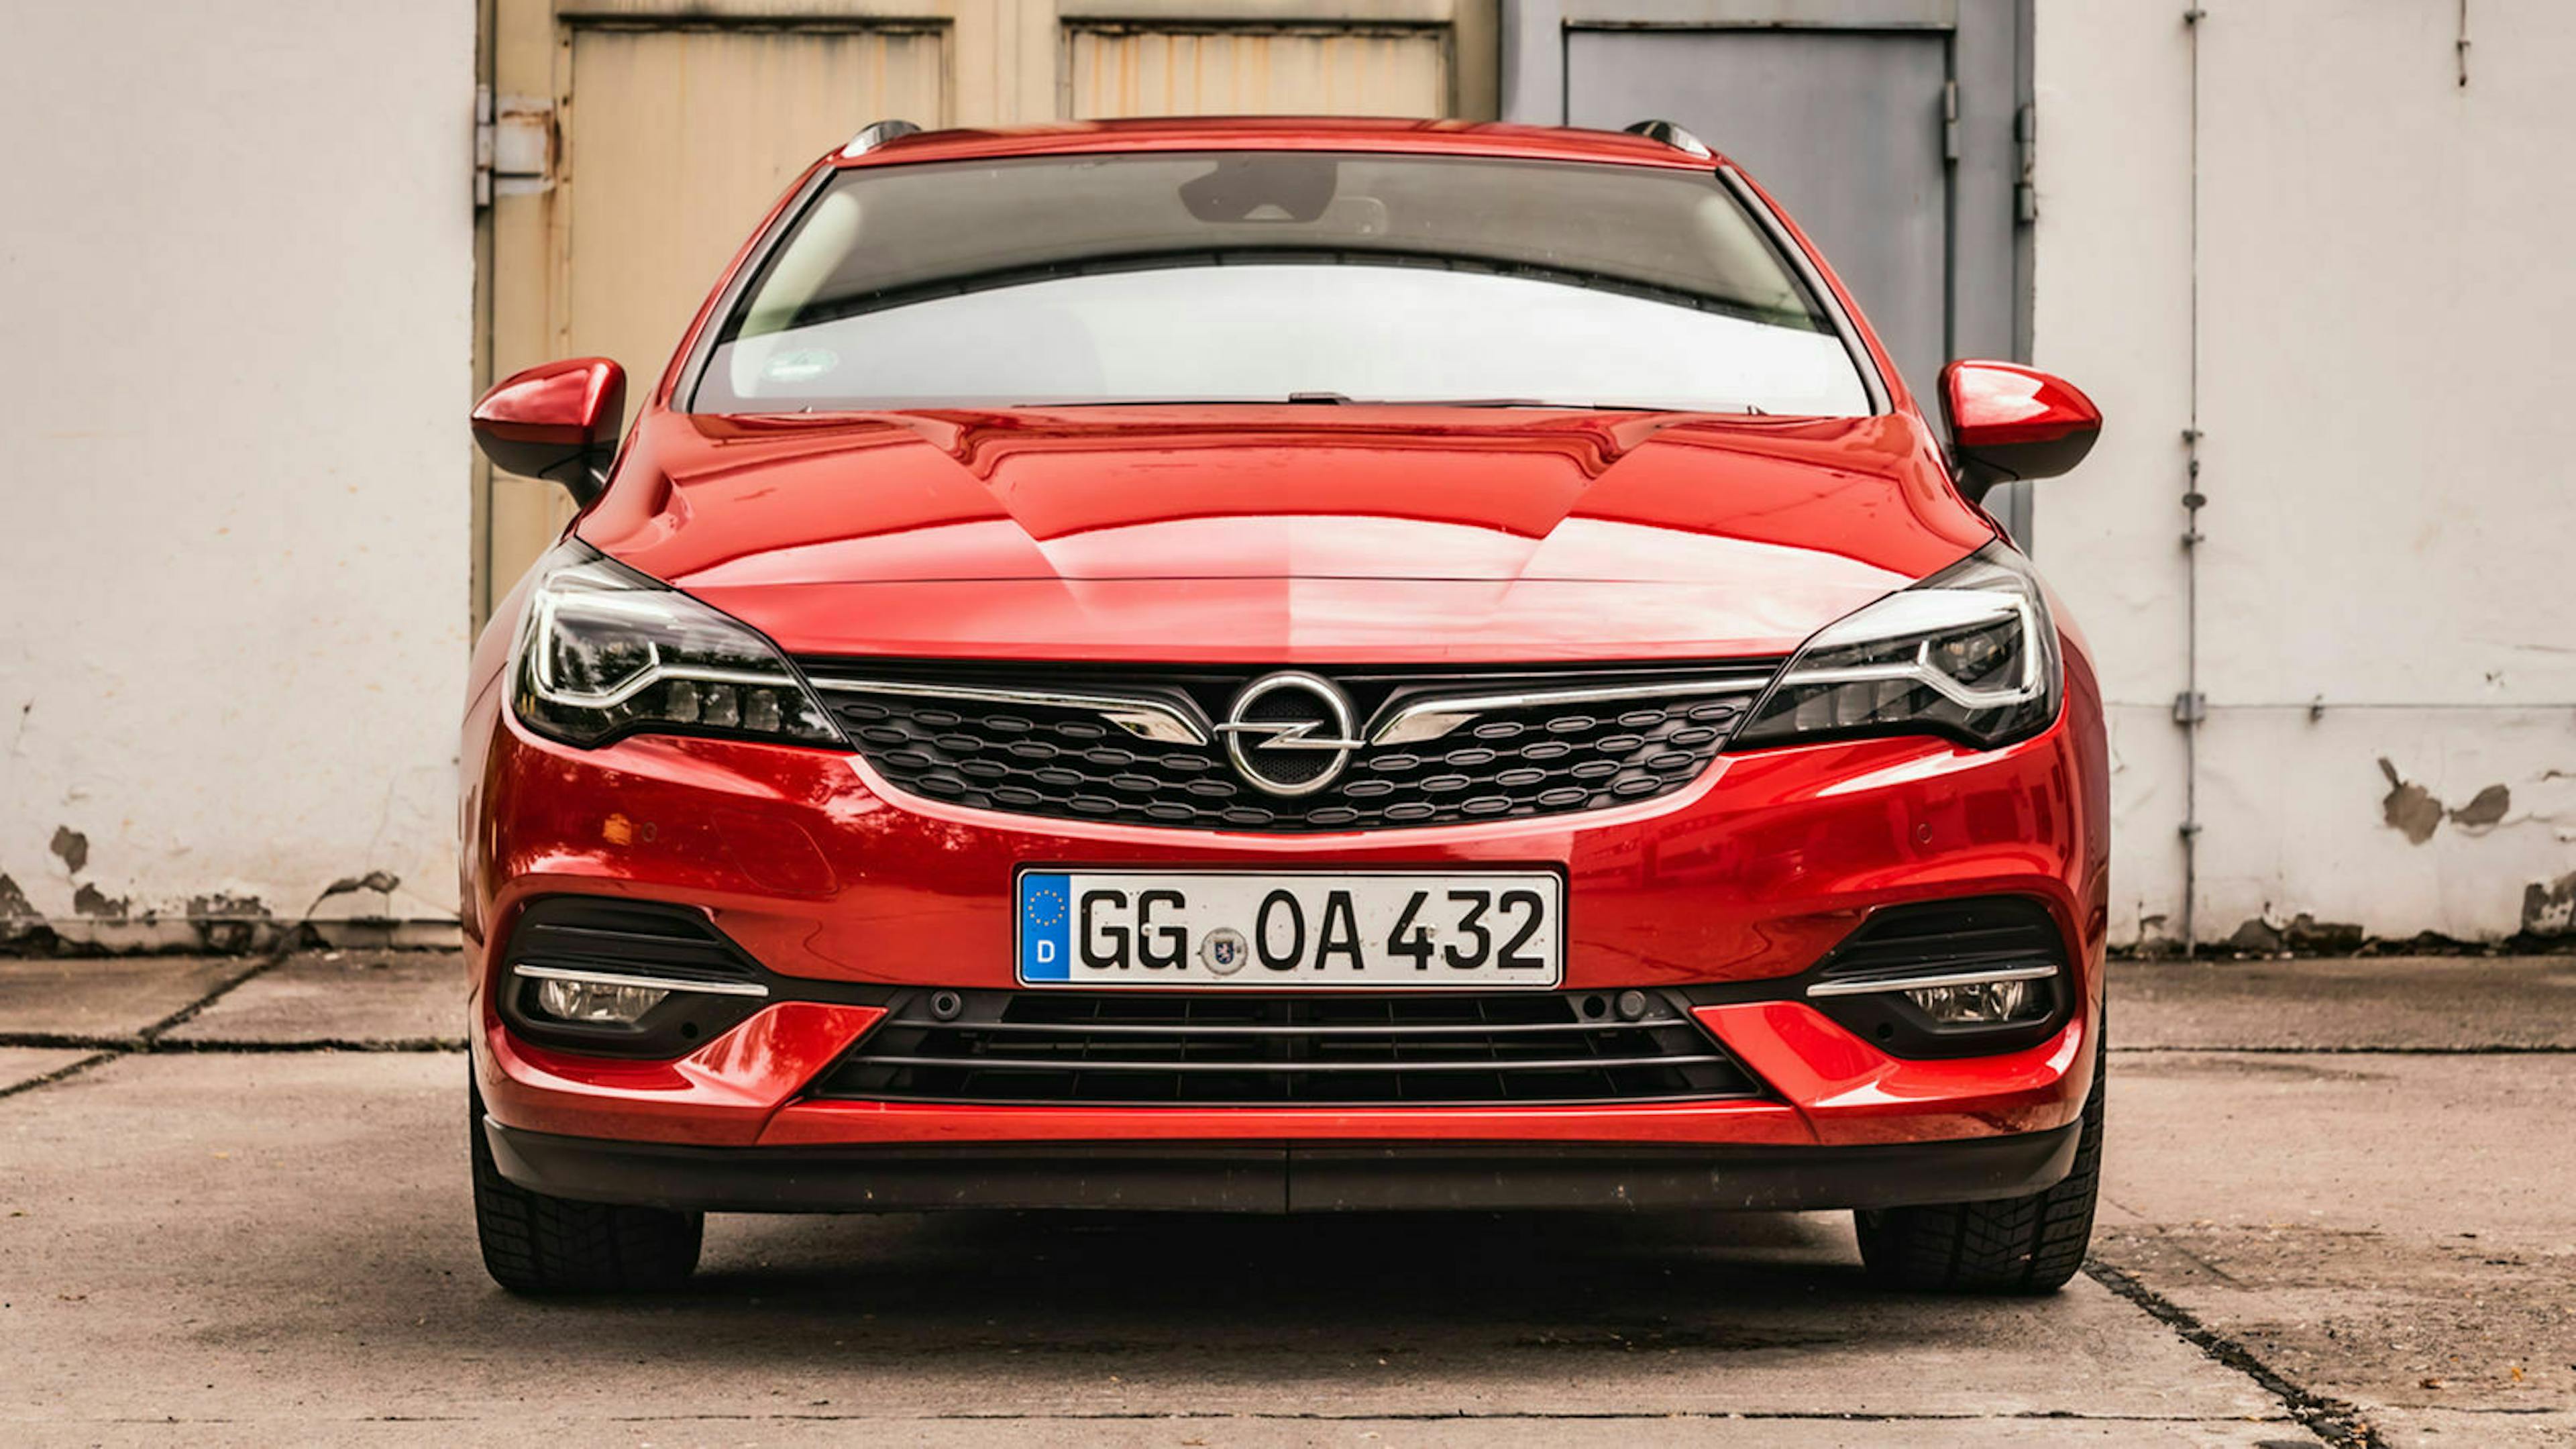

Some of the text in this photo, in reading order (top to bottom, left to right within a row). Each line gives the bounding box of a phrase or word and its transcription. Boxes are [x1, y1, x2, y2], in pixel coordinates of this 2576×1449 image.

[1037, 941, 1055, 963] D
[1080, 889, 1545, 970] GG OA 432
